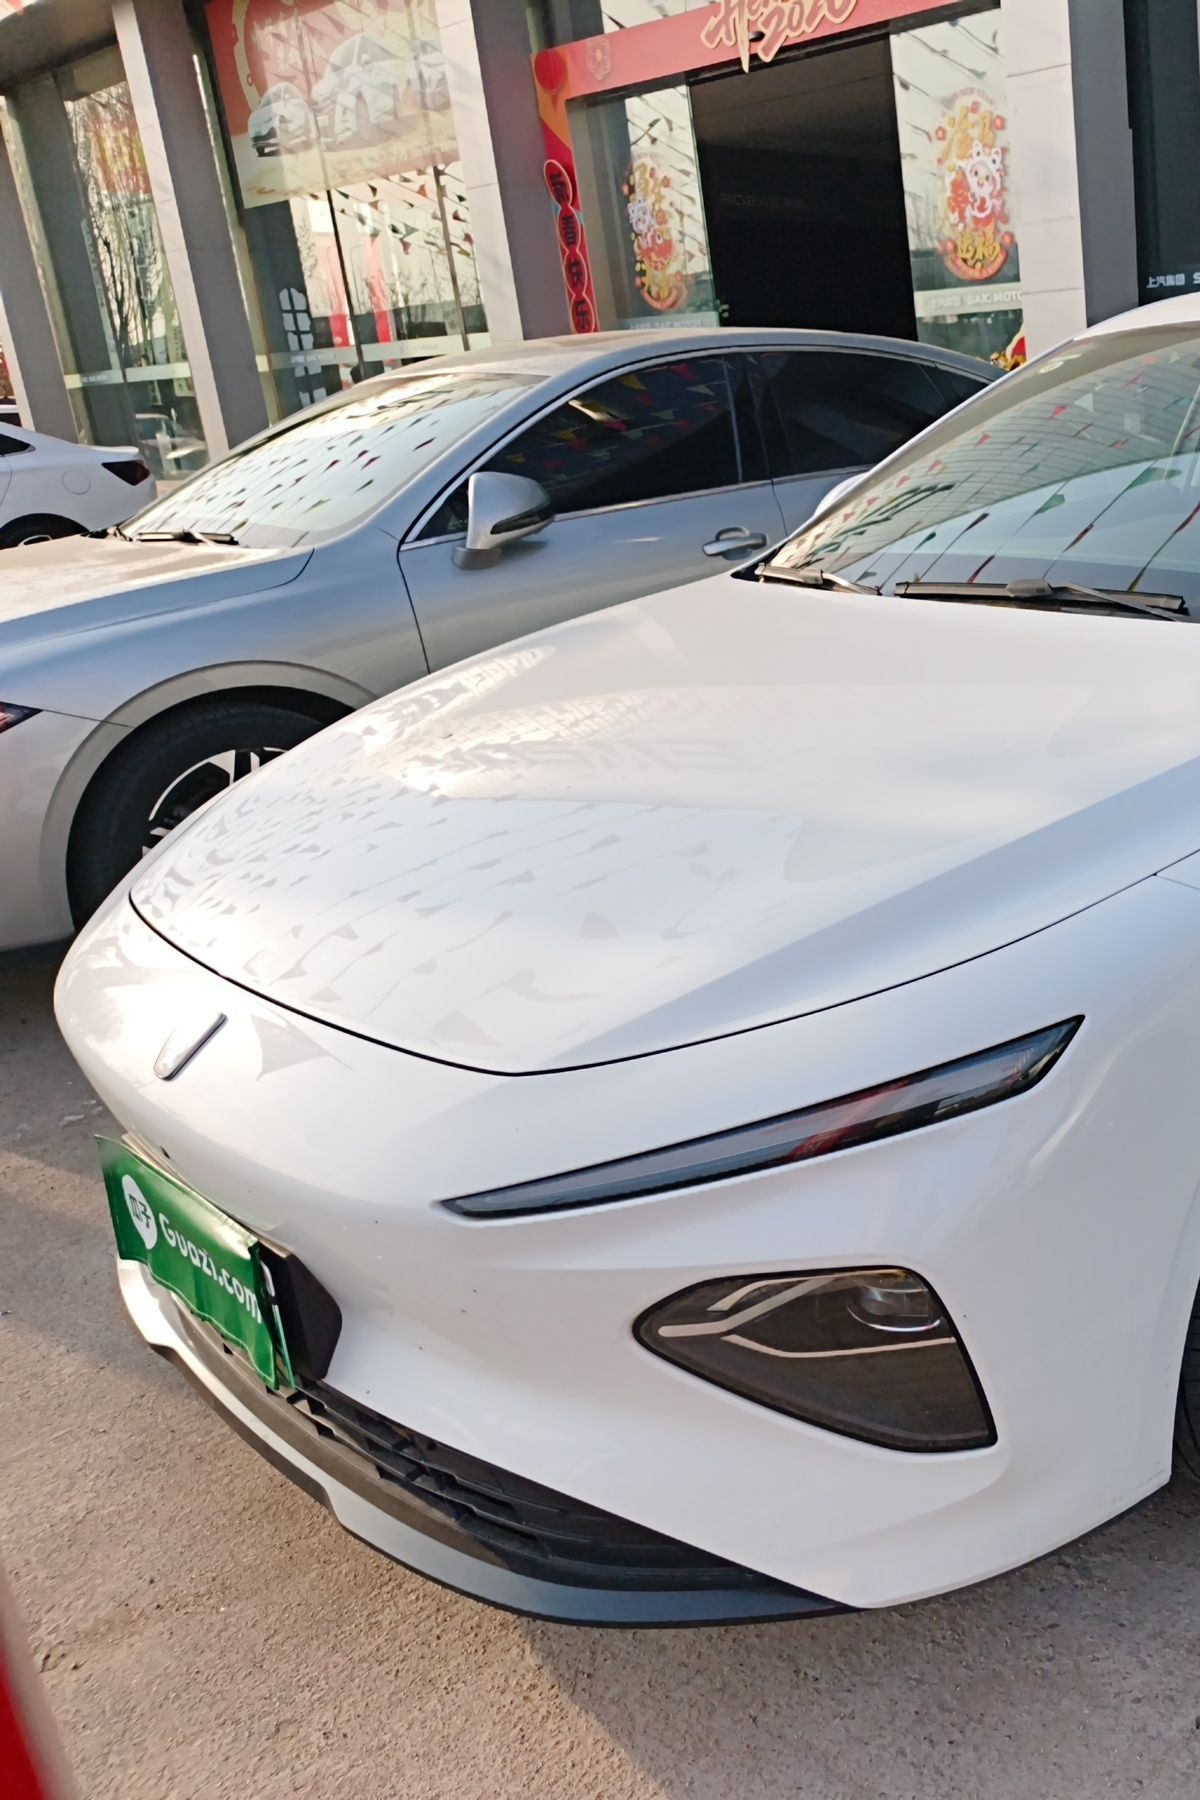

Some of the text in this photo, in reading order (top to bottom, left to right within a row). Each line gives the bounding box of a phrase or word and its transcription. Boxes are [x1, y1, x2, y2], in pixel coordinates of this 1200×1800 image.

[1146, 273, 1186, 288] 上汽集团
[128, 1193, 262, 1325] 瓜子 Guazi.com
